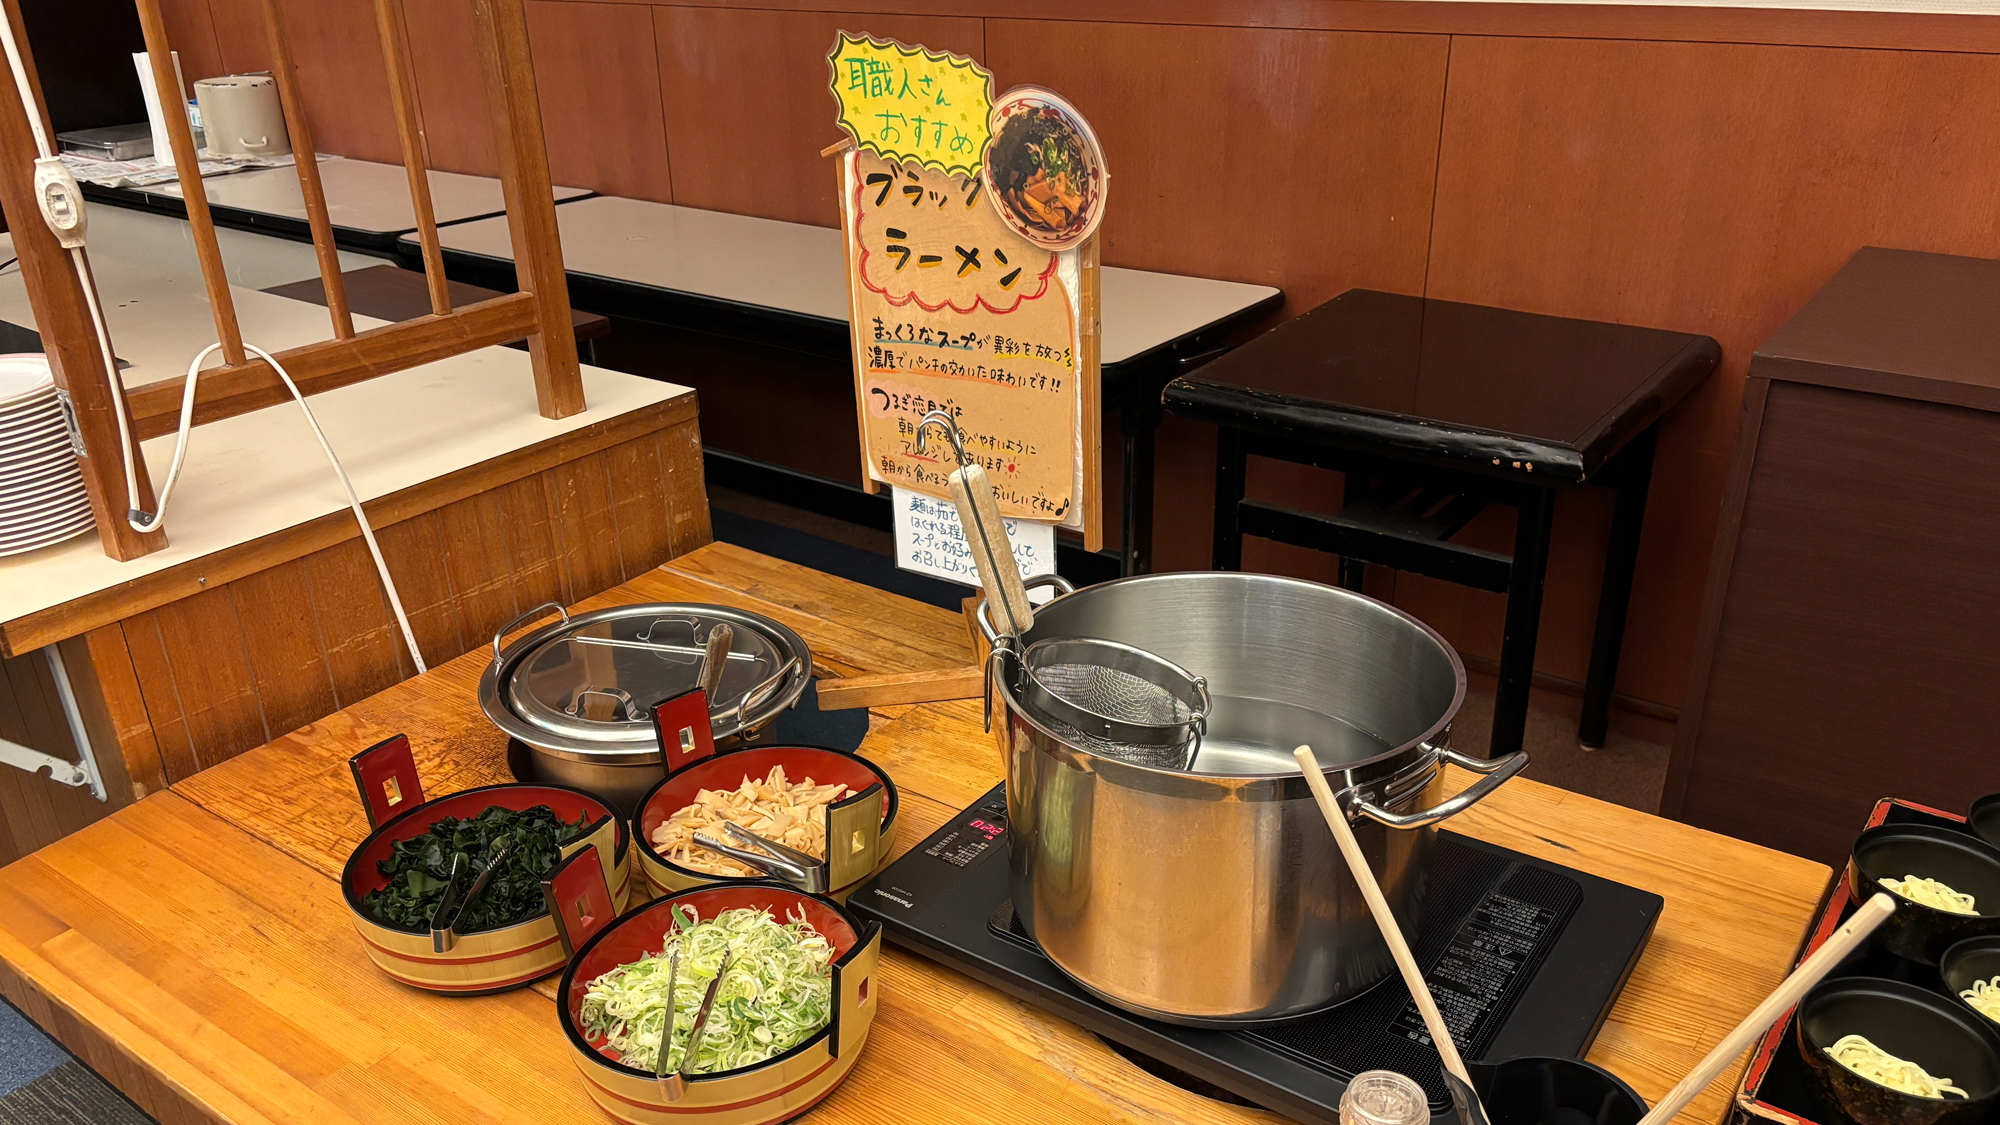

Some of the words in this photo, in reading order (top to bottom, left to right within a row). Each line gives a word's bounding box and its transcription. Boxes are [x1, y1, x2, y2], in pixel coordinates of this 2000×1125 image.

[843, 57, 951, 107] 職人さん
[875, 109, 974, 155] おすすめ
[866, 161, 983, 209] ブラック
[886, 227, 1022, 289] ラーメン
[872, 316, 1062, 362] まっくろなスープが異彩を放つ
[898, 416, 1037, 456] 朝らでも食べやすいように
[874, 888, 914, 909] Panasonic
